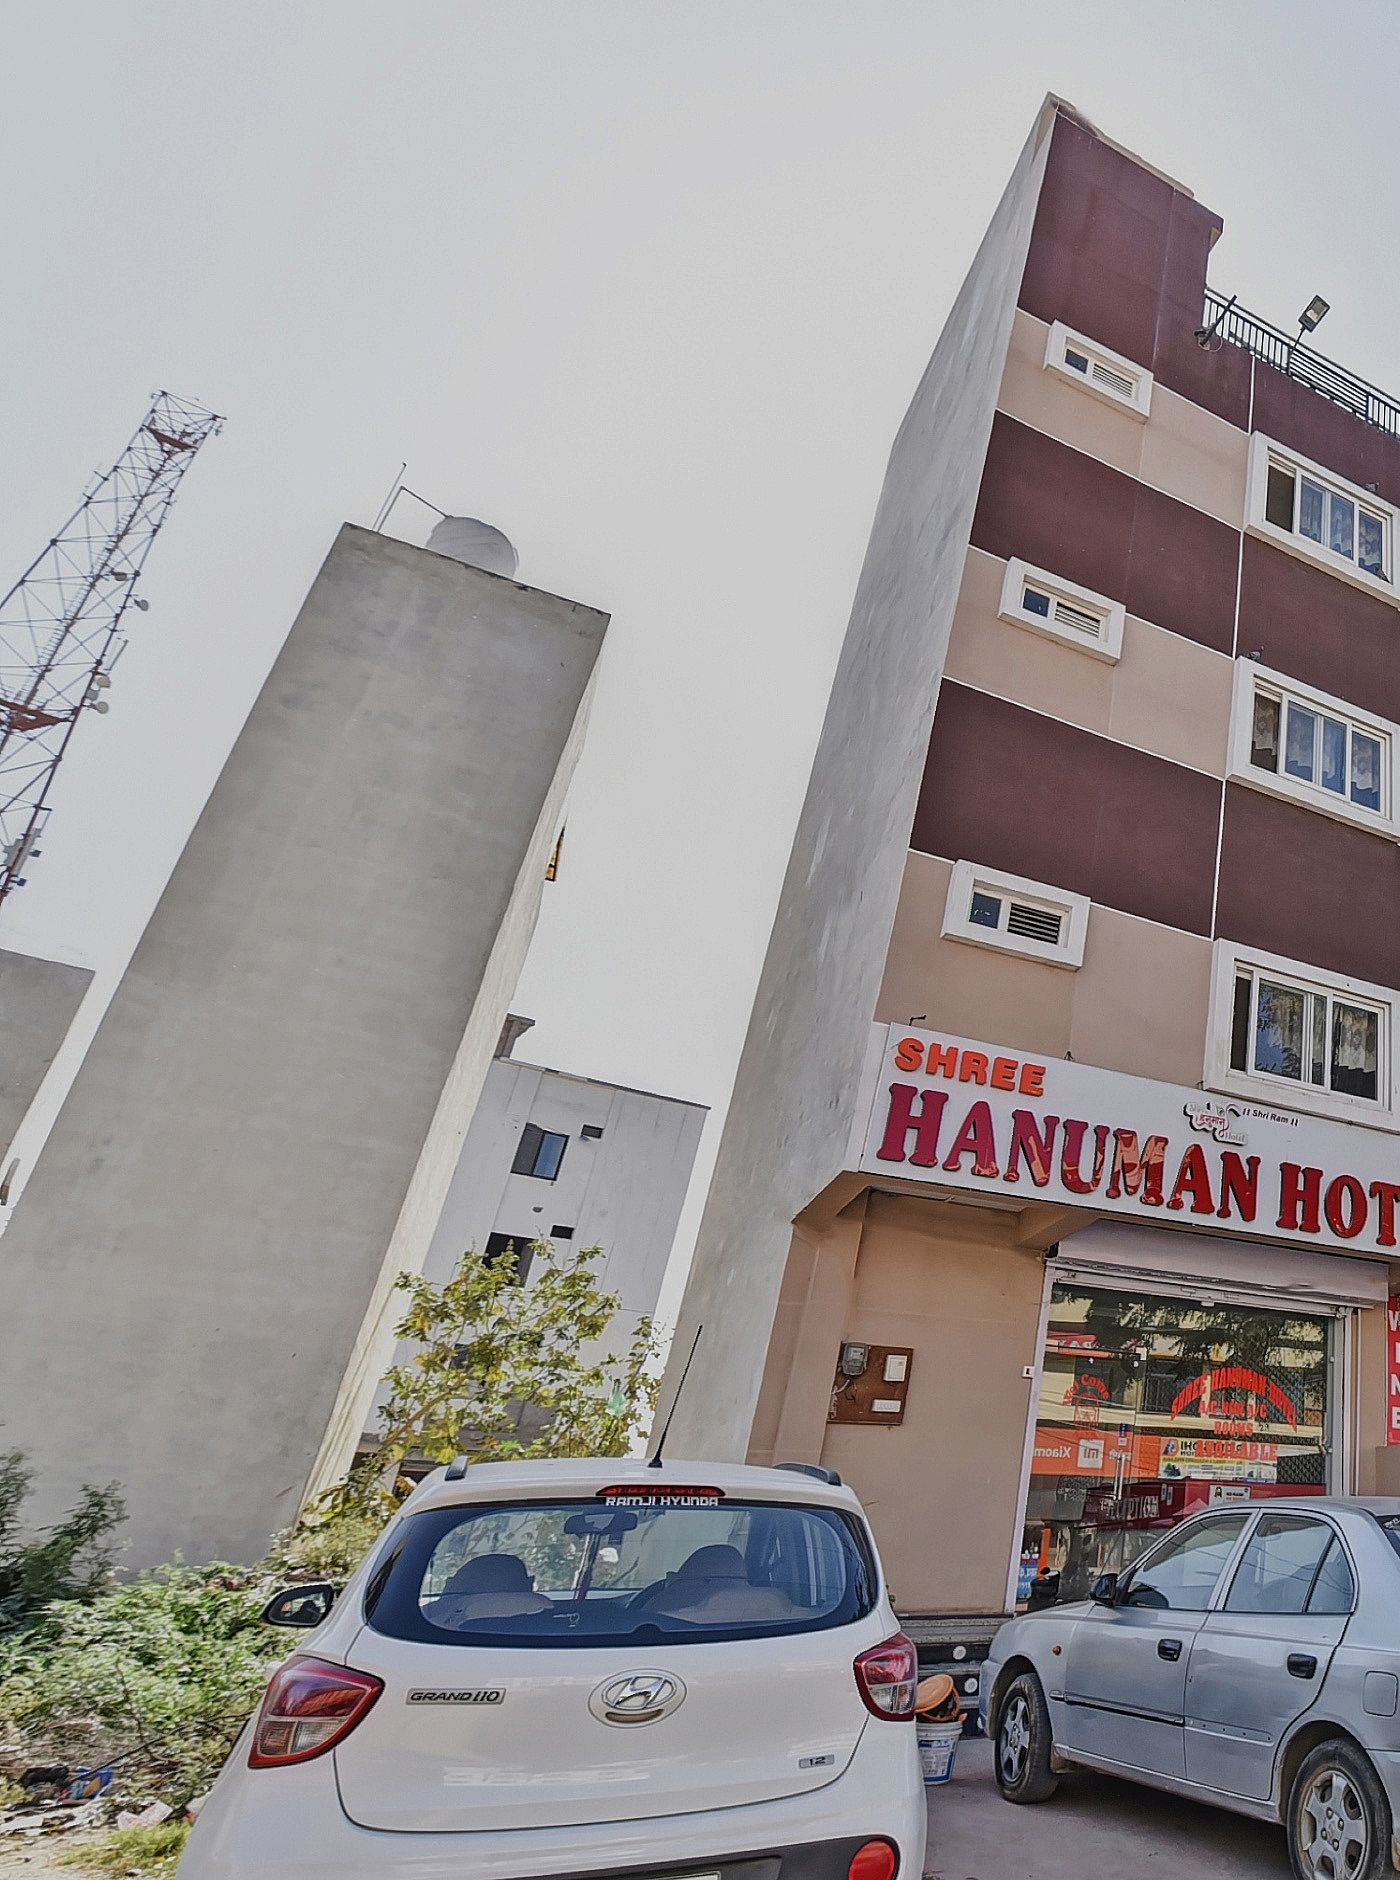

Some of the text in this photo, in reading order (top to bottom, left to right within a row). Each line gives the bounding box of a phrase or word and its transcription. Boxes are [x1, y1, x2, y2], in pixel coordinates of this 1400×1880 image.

[895, 1036, 1046, 1097] SHREE
[1252, 1109, 1269, 1120] Shri
[1270, 1113, 1289, 1124] Ram
[876, 1082, 1262, 1222] HANUMAN
[1213, 1420, 1254, 1437] ROOMS
[605, 1495, 656, 1507] RAMJI
[410, 1691, 473, 1702] GRAND
